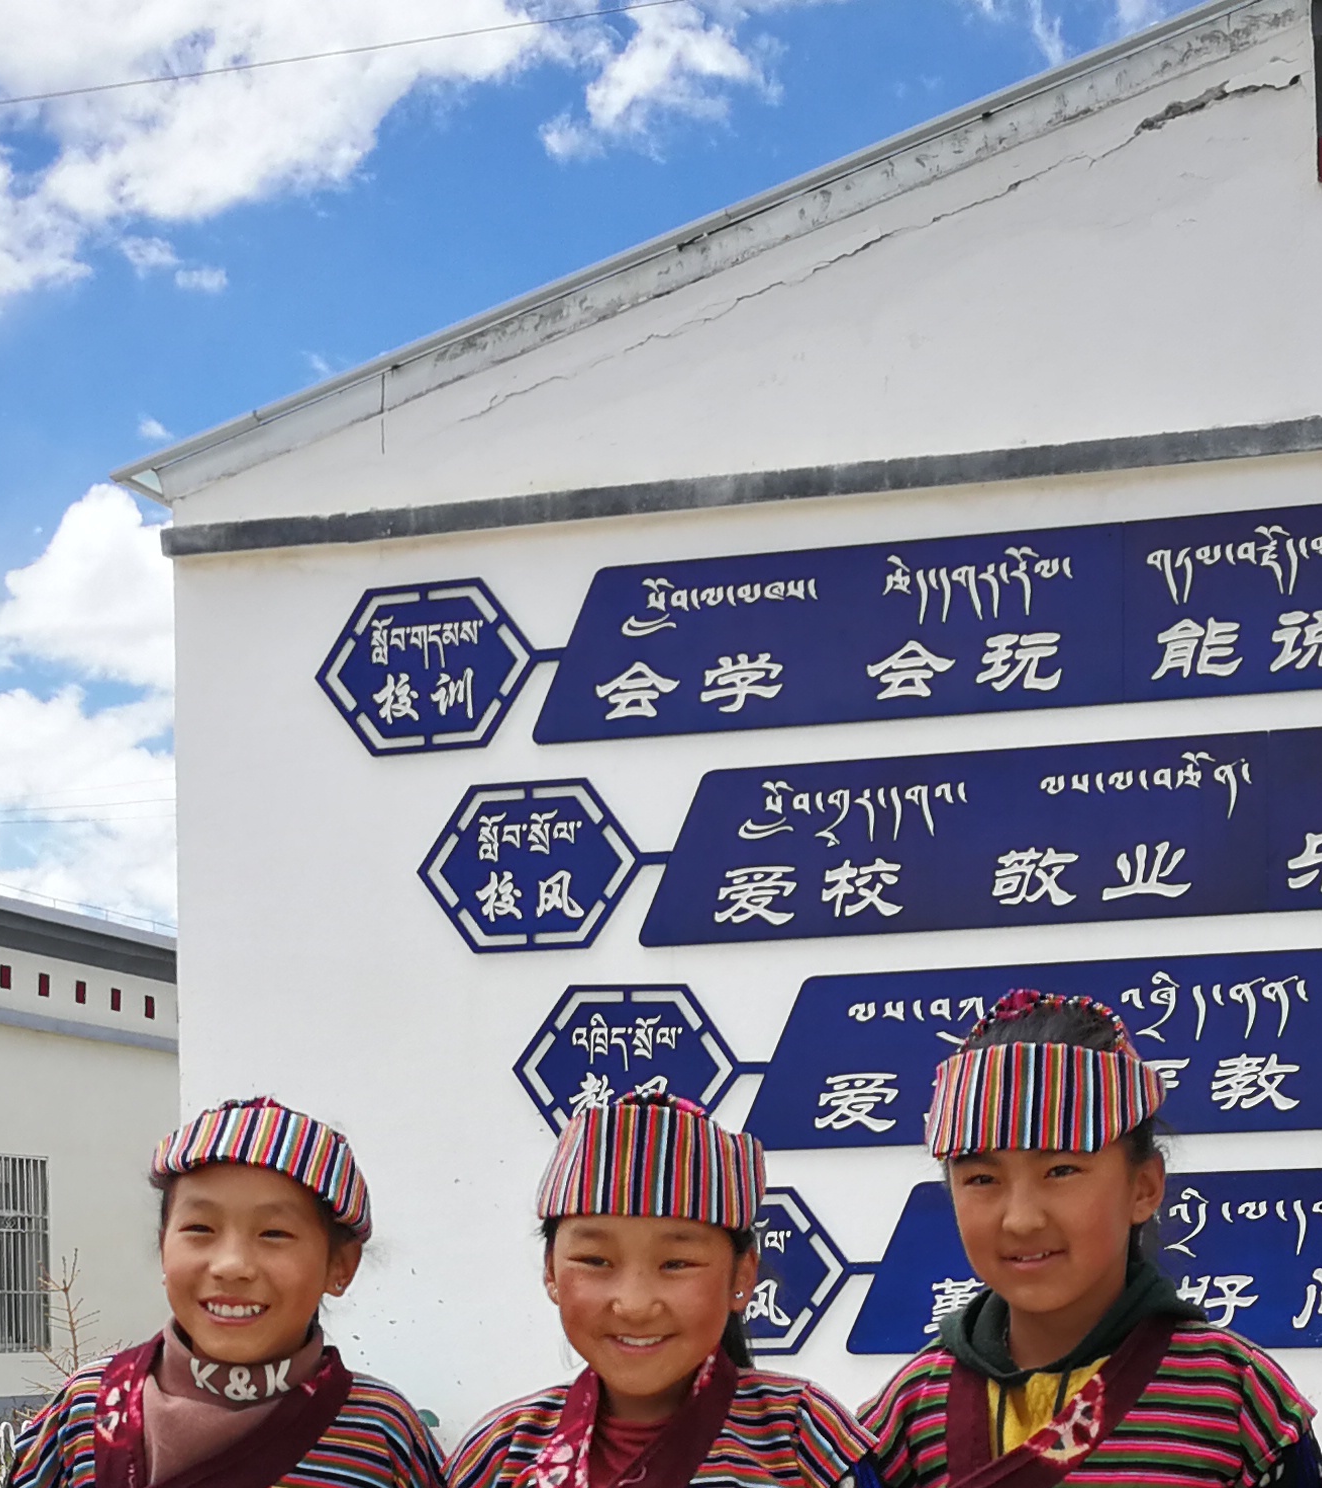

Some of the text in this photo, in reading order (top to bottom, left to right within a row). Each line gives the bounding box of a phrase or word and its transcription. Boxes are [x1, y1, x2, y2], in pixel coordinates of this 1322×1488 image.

[372, 667, 474, 724] 校训
[595, 653, 784, 720] 会学
[866, 632, 1063, 700] 会玩
[475, 870, 585, 922] 校风
[714, 858, 904, 926] 爱校
[992, 841, 1192, 906] 敬业
